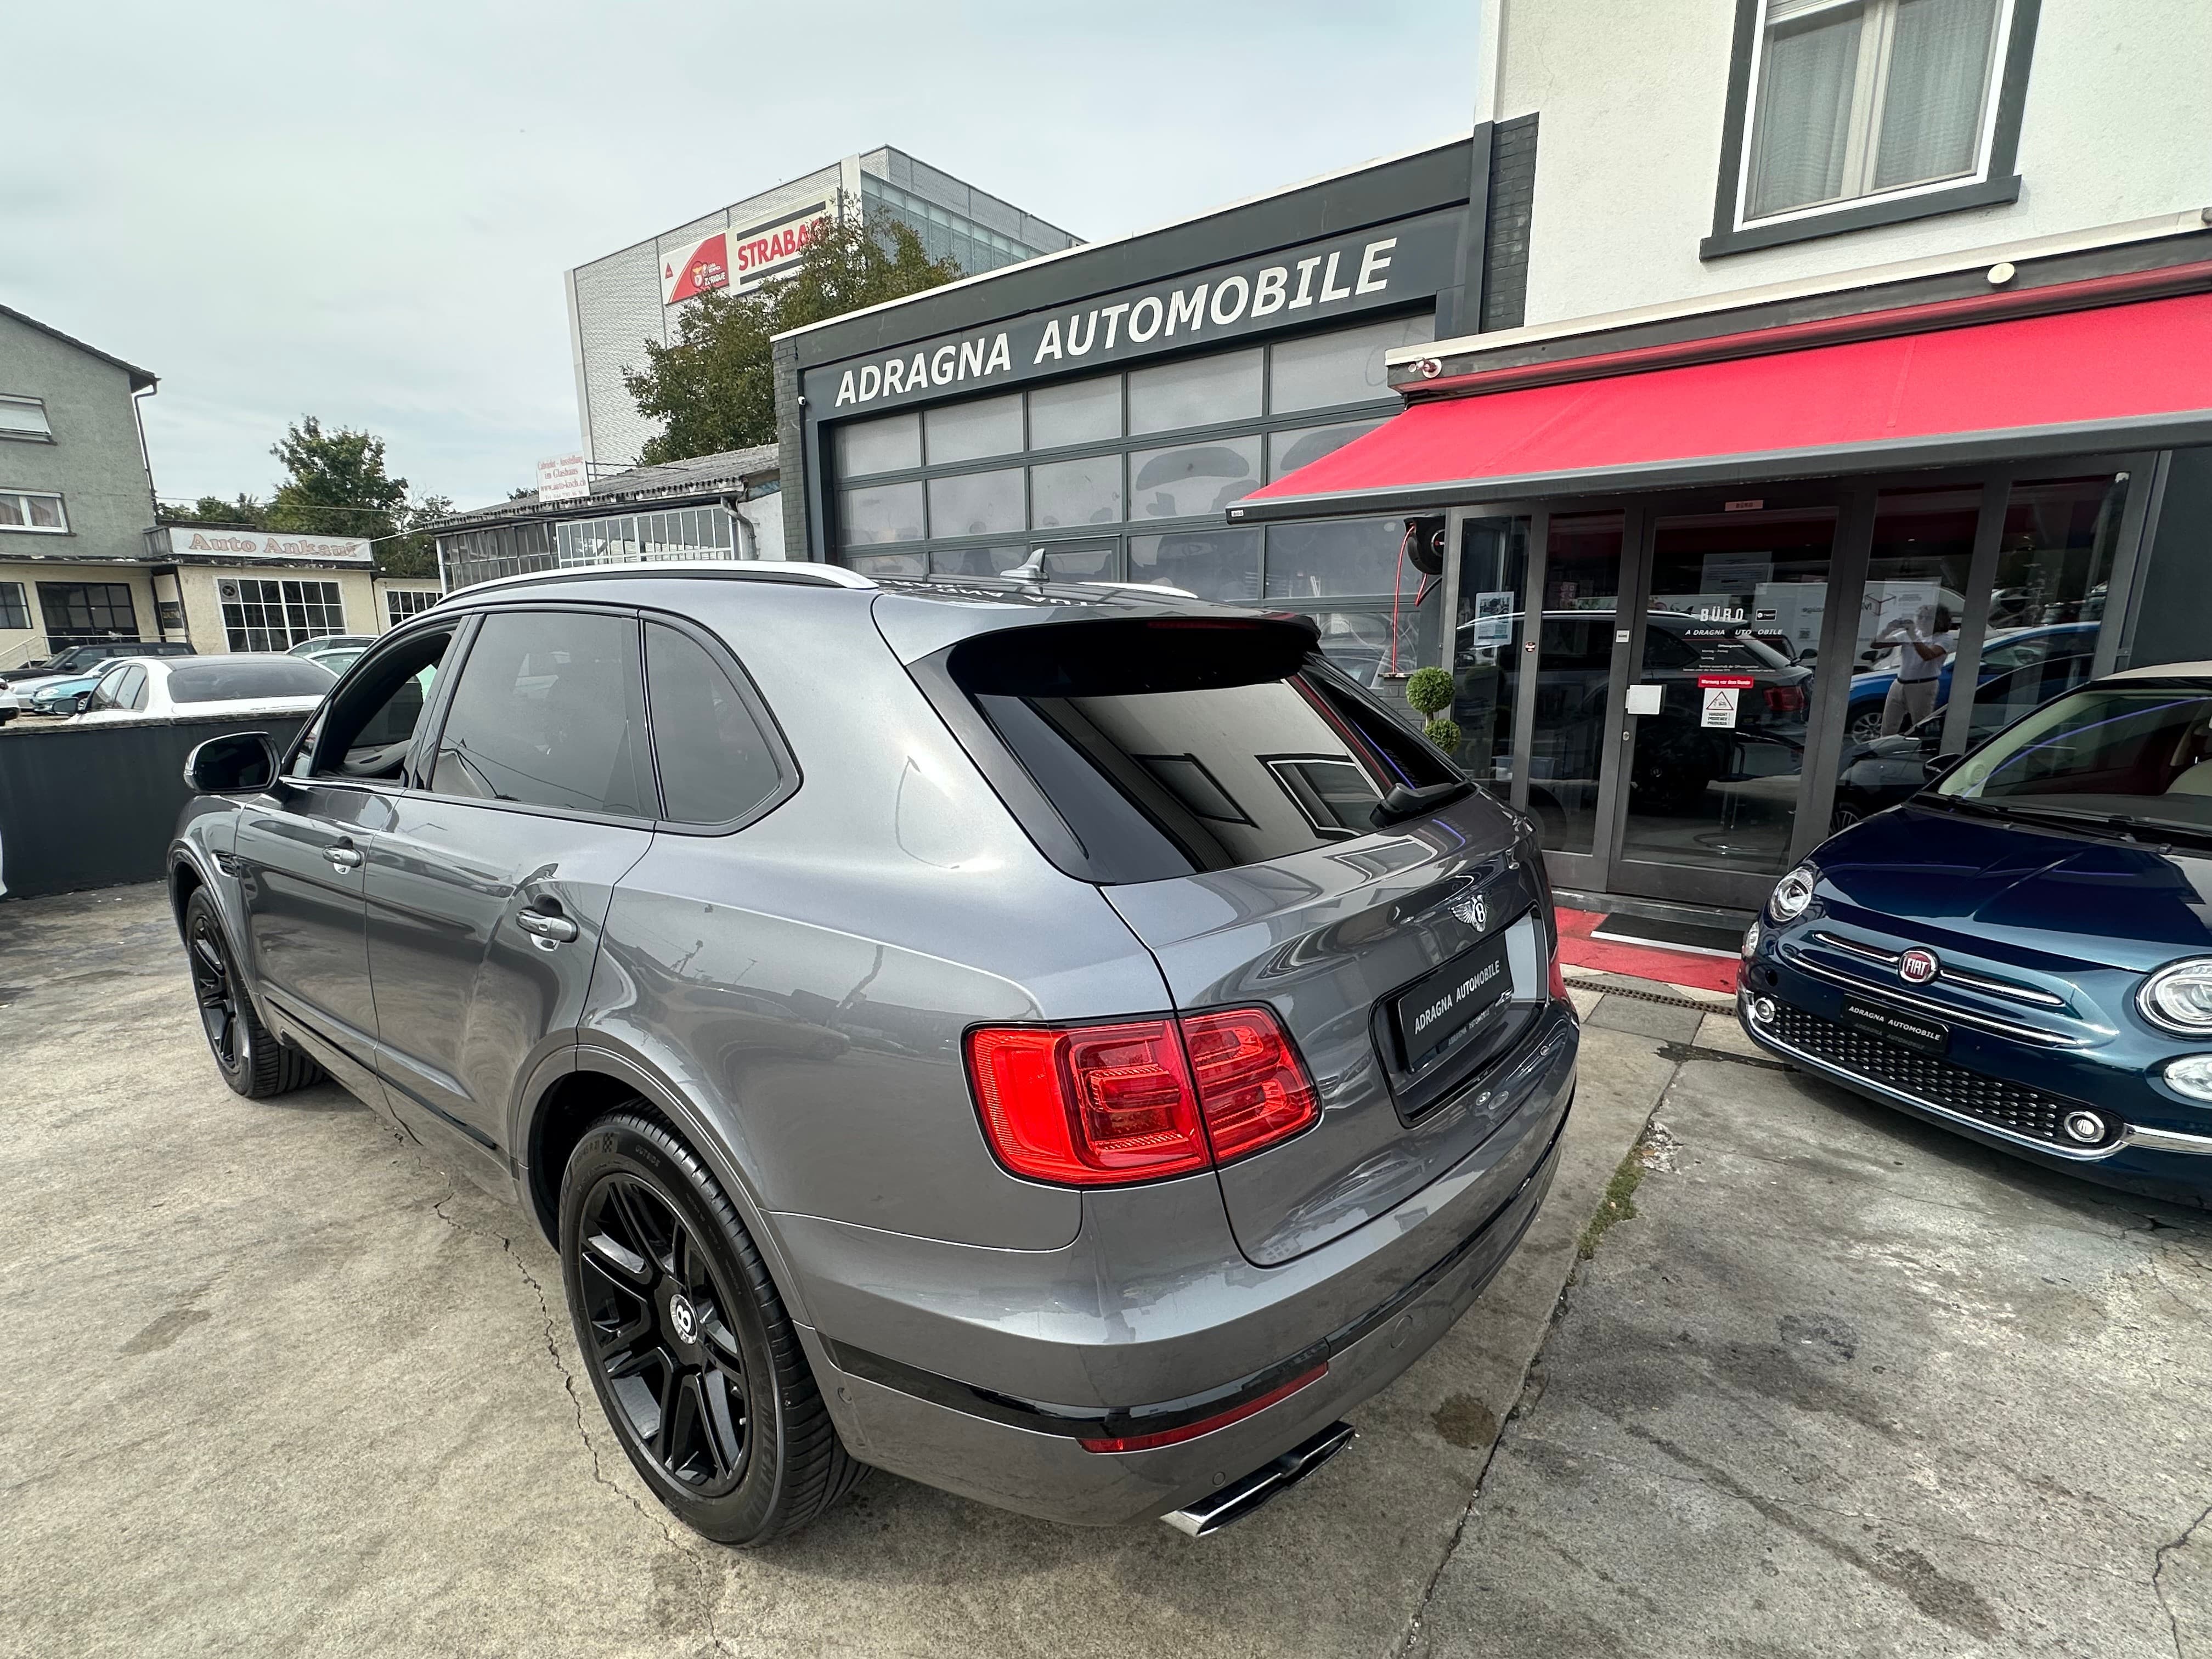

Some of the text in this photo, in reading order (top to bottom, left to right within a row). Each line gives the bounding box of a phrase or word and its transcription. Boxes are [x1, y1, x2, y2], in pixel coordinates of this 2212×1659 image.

[834, 237, 1398, 408] ADRAGNA AUTOMOBILE
[189, 533, 359, 557] Auto Ankauf
[1700, 606, 1744, 622] BÜRO
[1905, 957, 1929, 977] FIAT
[1414, 960, 1500, 1035] ADRAGNA AUTOMOBILE
[1848, 1006, 1941, 1041] ADRAGNA AUTOMOBILE
